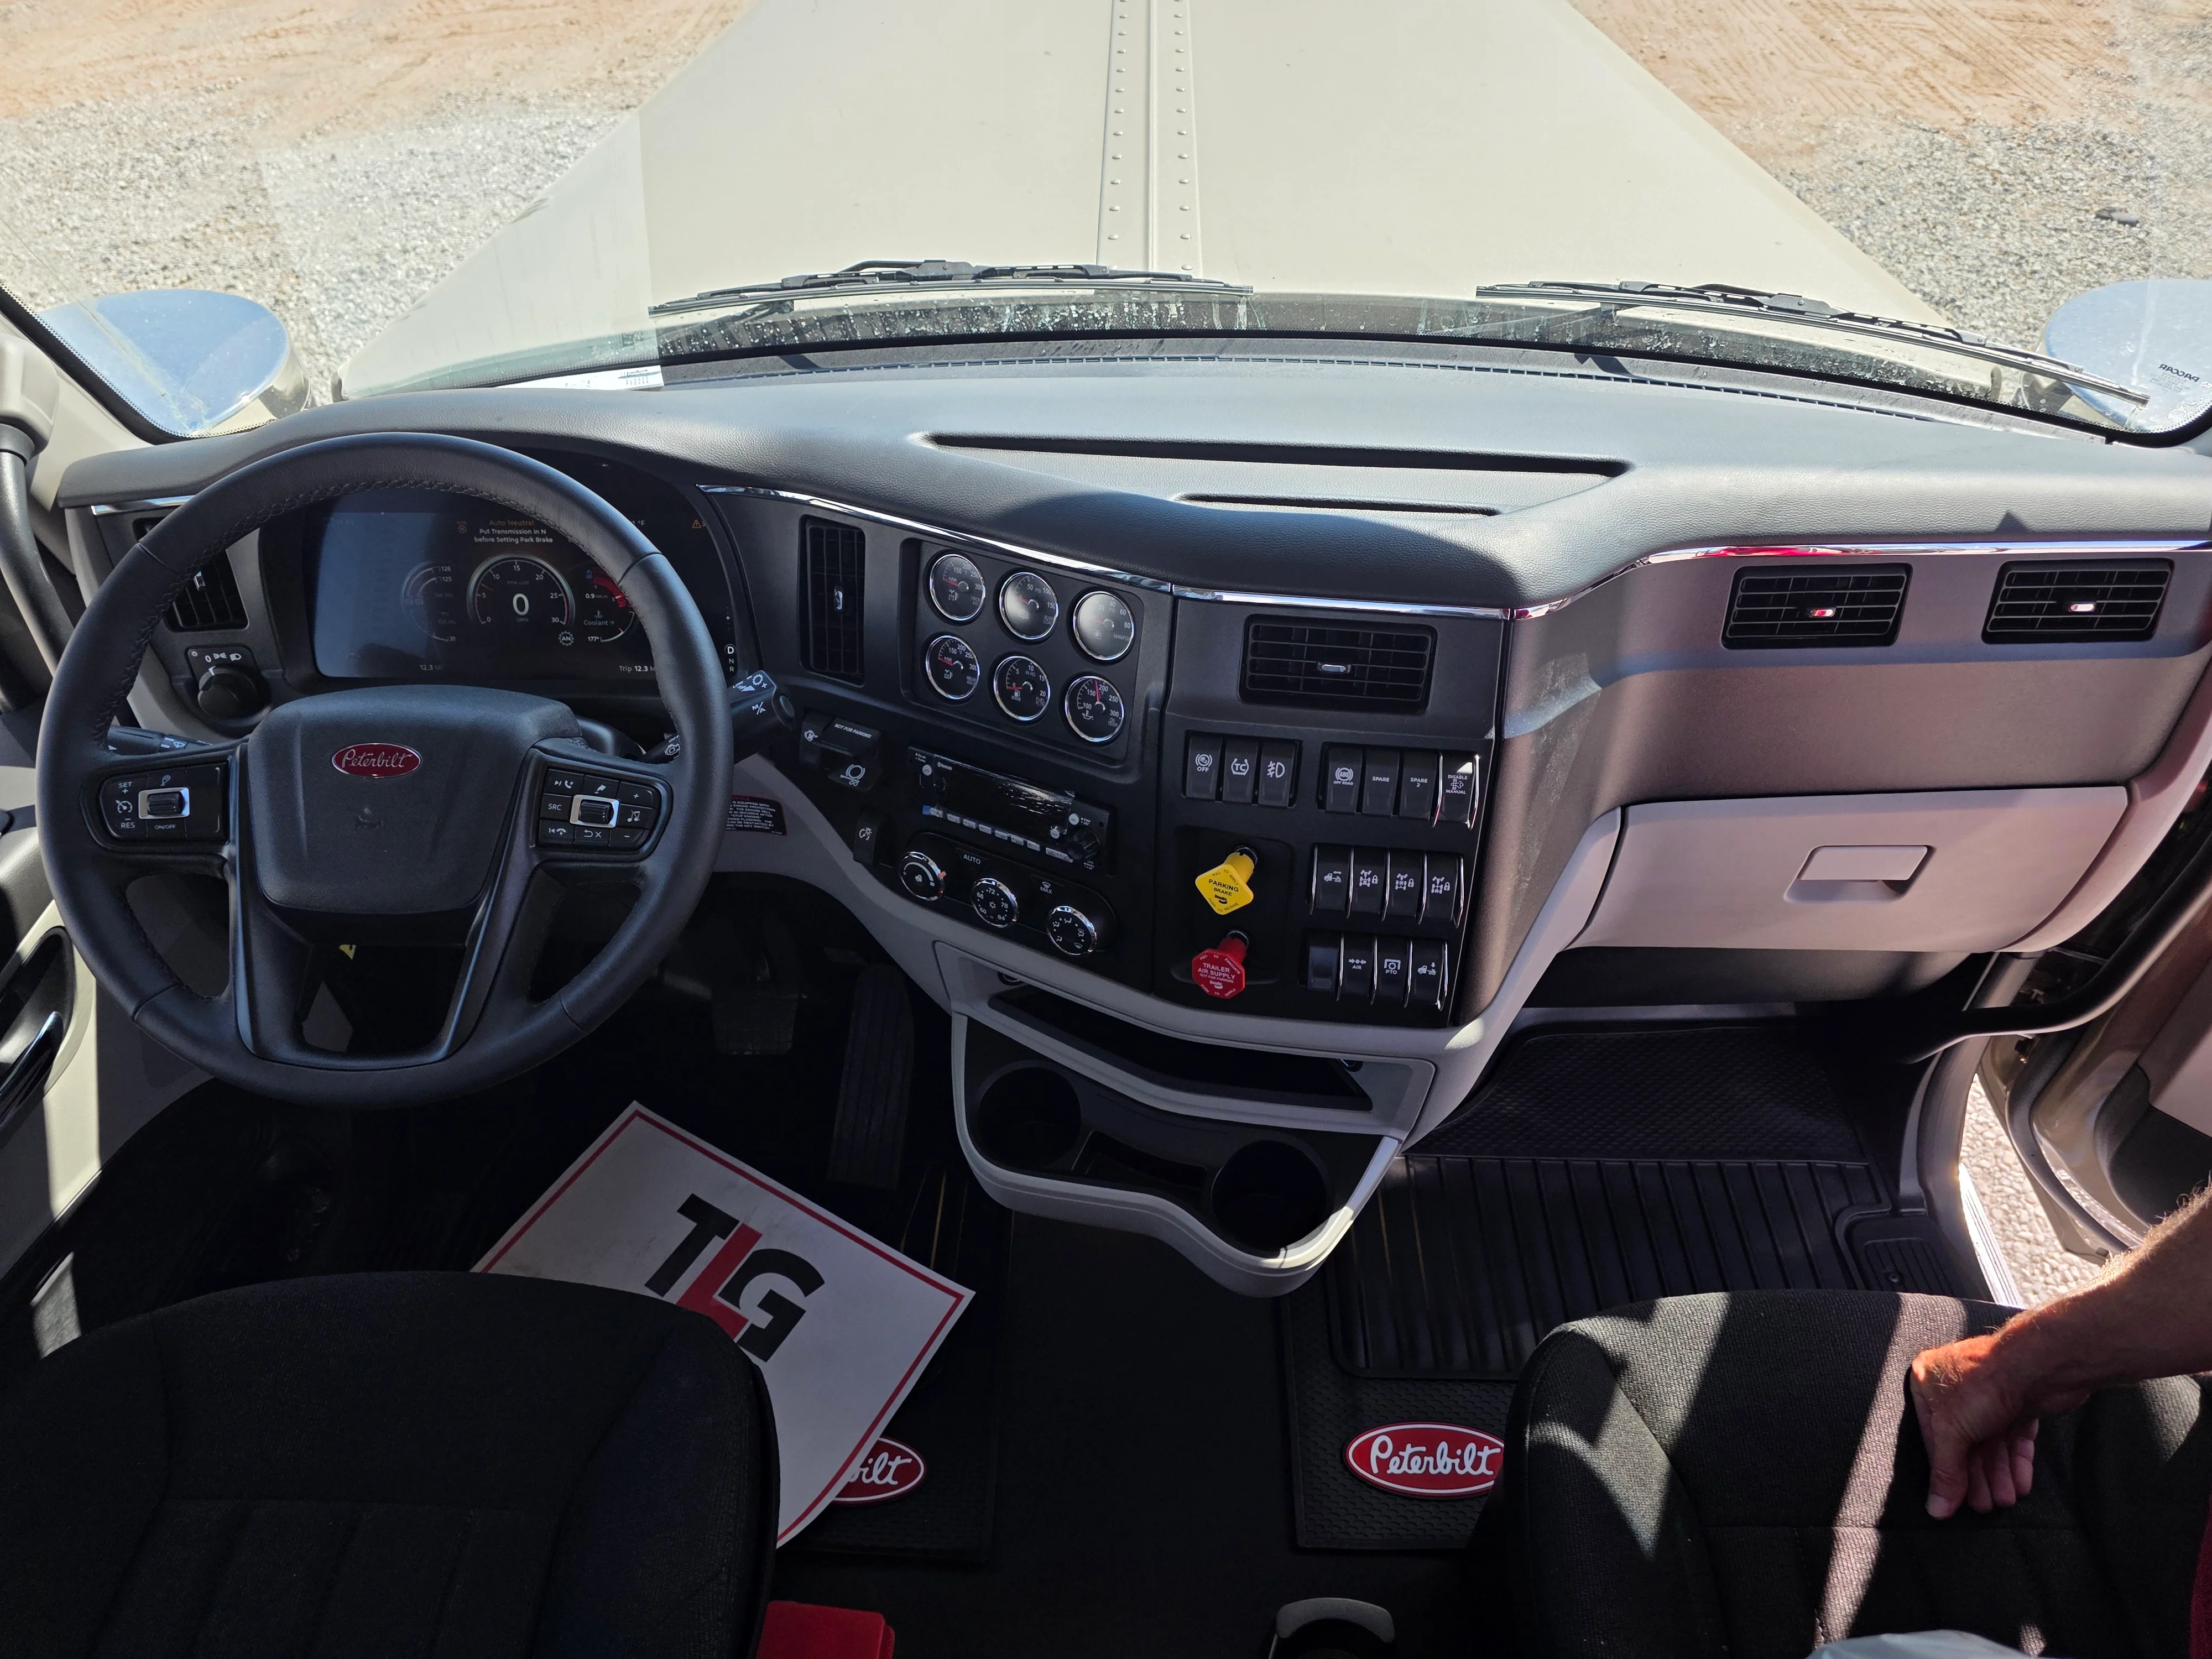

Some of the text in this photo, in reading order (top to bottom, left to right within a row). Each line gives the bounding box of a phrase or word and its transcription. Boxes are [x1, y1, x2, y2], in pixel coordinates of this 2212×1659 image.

[513, 593, 529, 615] 0
[727, 646, 734, 654] D
[732, 680, 744, 688] LOW
[752, 701, 766, 715] M/A
[852, 729, 872, 739] PARKING
[342, 749, 413, 768] Peterbilt
[1234, 763, 1246, 771] TC
[963, 854, 981, 864] AUTO
[1229, 874, 1239, 885] APPLY
[1040, 886, 1052, 894] MAX
[1208, 879, 1239, 892] PARKING
[1213, 887, 1233, 896] BRAKE
[1208, 898, 1217, 907] PUSH
[1224, 902, 1239, 911] RELEASE
[1203, 962, 1230, 973] TRAILER
[1224, 957, 1241, 974] EVACUATE
[1210, 970, 1235, 980] SUPPLY
[644, 1193, 826, 1363] TLG
[1370, 1434, 1501, 1475] Peterbilt
